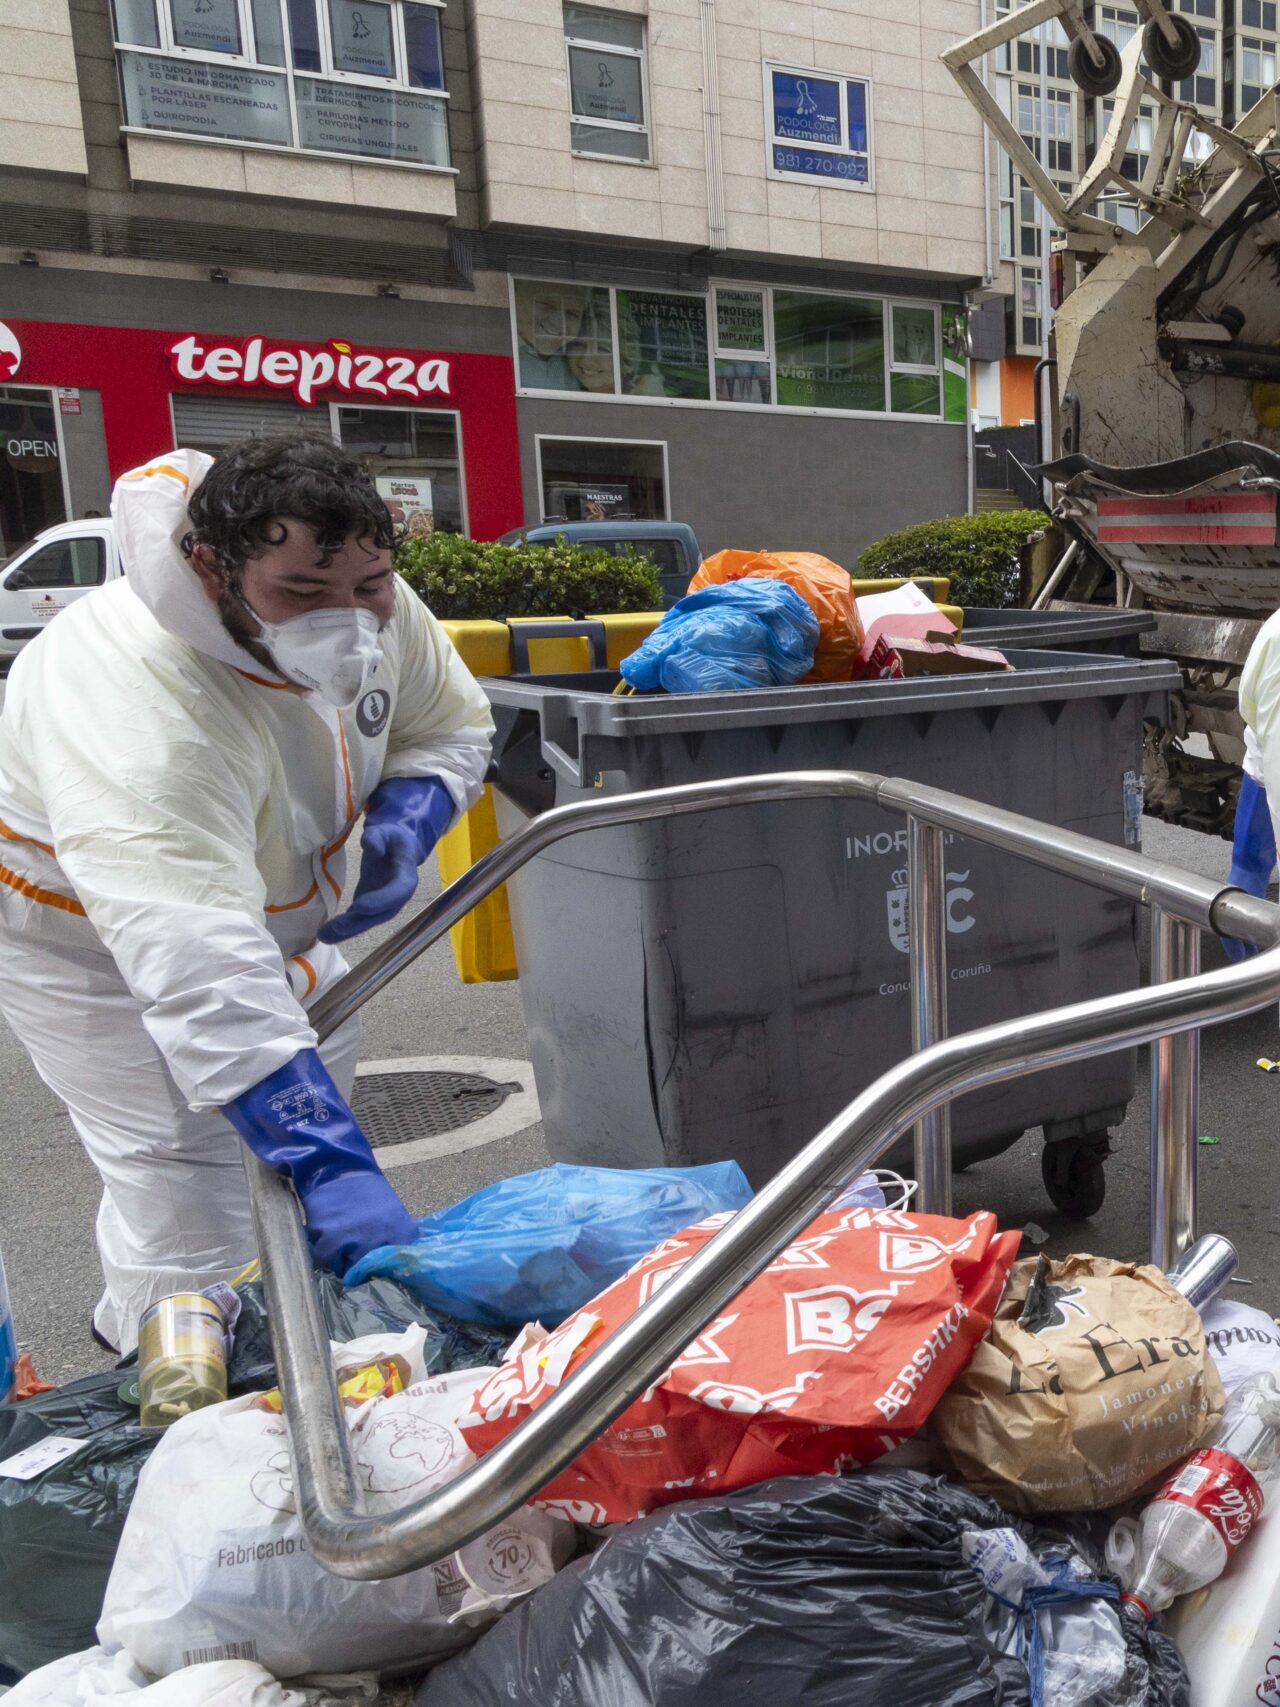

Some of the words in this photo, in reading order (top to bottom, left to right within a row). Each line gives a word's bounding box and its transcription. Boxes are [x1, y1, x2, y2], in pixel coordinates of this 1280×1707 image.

[184, 29, 231, 44] Auzmendi
[148, 62, 192, 76] ESTUDIO
[343, 53, 386, 67] Auzmendi
[150, 71, 162, 79] 3D
[165, 73, 179, 81] DE
[181, 75, 194, 84] LA
[197, 78, 240, 91] MARCHA
[151, 86, 211, 102] PLANTILLAS
[215, 95, 278, 111] ESCANEADAS
[152, 95, 173, 105] POR
[315, 86, 384, 104] TRATAMIENTOS
[317, 110, 369, 123] PAPILOMAS
[371, 115, 410, 129] MÉTODO
[318, 118, 361, 130] CRYOPEN
[319, 132, 363, 145] CIRUGÍAS
[365, 138, 418, 152] UNGUEALES
[778, 125, 838, 143] Auzmendi
[776, 152, 800, 168] 981
[805, 157, 833, 172] 270
[837, 161, 865, 177] 092
[630, 303, 705, 319] DENTALES
[718, 316, 761, 328] DENTALES
[719, 332, 763, 344] IMPLANTES
[171, 336, 451, 403] telepizza
[7, 439, 57, 457] OPEN
[951, 962, 992, 980] Coruña
[873, 1301, 969, 1422] BERSHKA
[1081, 1322, 1201, 1383] Era
[217, 1537, 295, 1568] Fabricado
